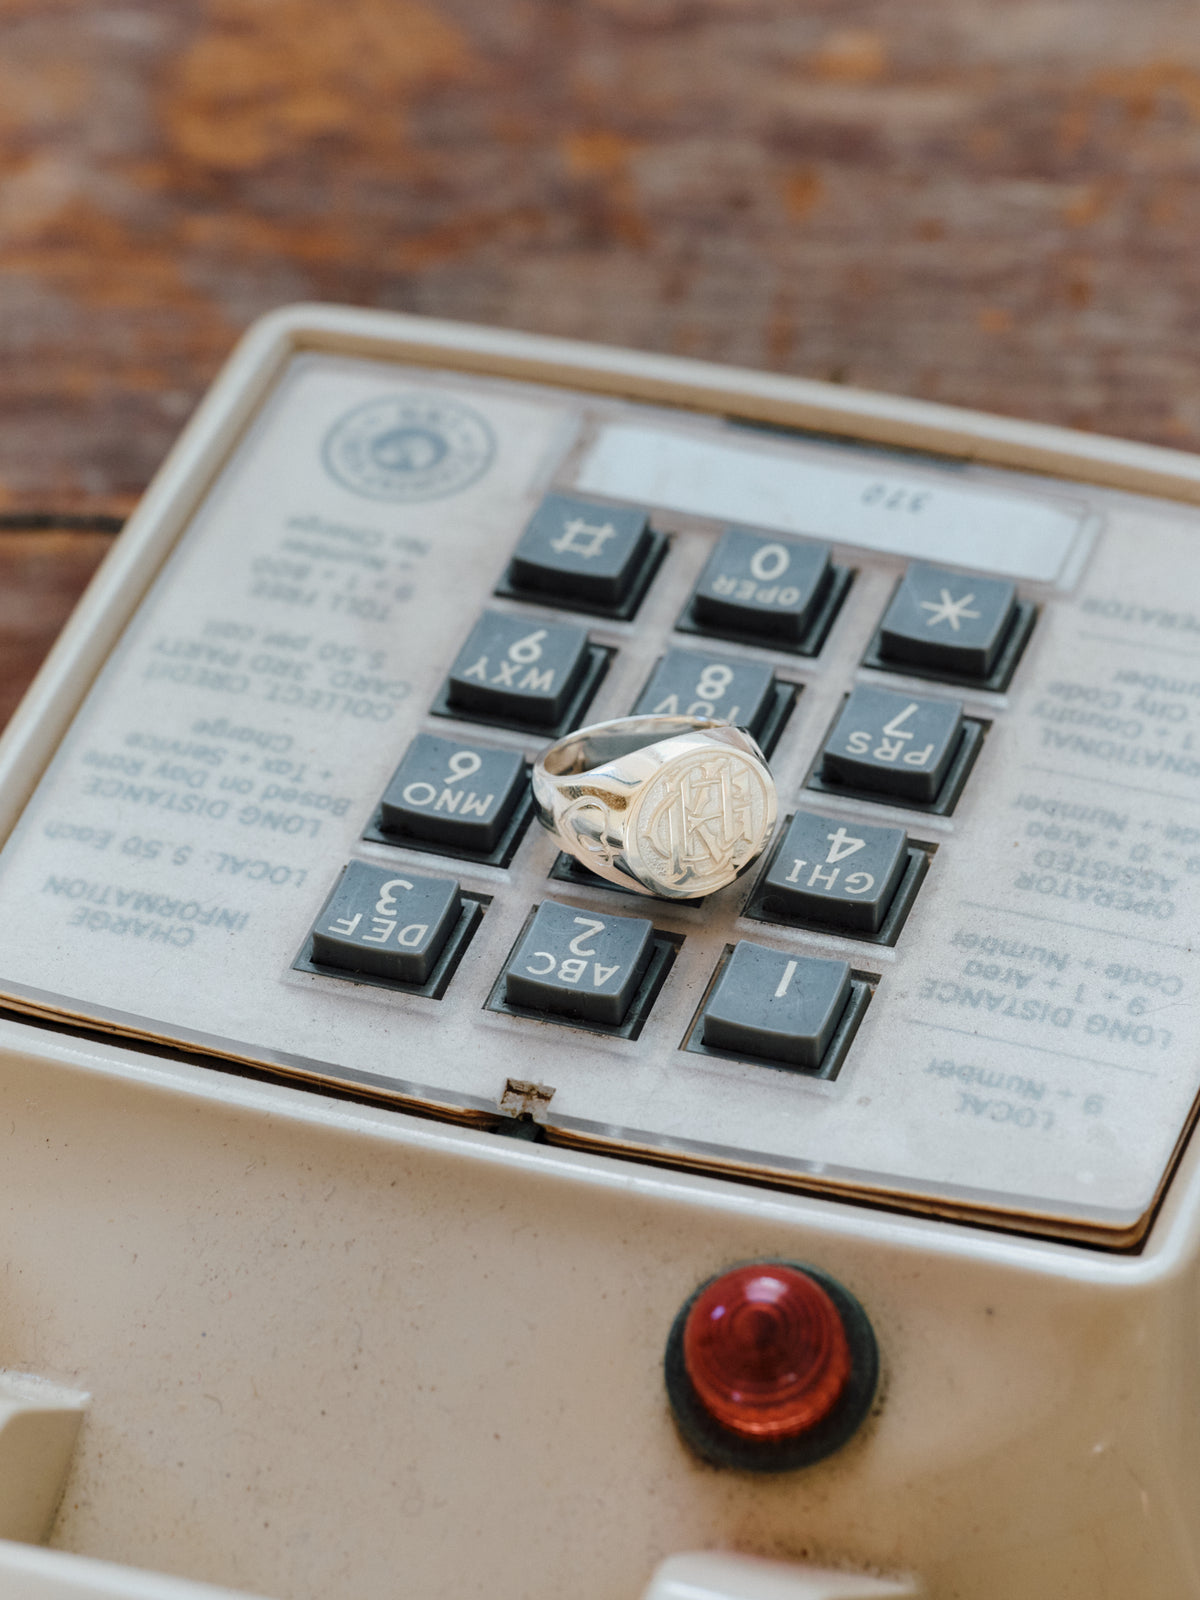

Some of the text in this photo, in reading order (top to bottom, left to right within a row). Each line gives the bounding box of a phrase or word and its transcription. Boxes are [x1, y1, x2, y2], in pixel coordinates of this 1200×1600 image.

[711, 575, 799, 606] OPER
[508, 630, 548, 664] 9
[463, 655, 555, 692] WXY
[696, 664, 734, 701] 8
[191, 718, 294, 753] Charge
[882, 703, 918, 740] 7
[845, 731, 935, 766] PRS
[153, 761, 208, 789] Day
[219, 775, 254, 795] on
[443, 750, 482, 785] 6
[81, 776, 322, 838] LONG DISTANCE
[260, 783, 350, 817] Based
[402, 782, 495, 817] MNO
[825, 827, 866, 863] 4
[785, 858, 875, 894] GHI
[41, 875, 250, 932] INFORMATION
[375, 879, 414, 916] 3
[1013, 872, 1176, 921] OPERATOR
[67, 906, 194, 948] CHARGE
[327, 912, 429, 947] DEF
[569, 916, 606, 957] 2
[525, 951, 620, 987] ABC
[950, 932, 1070, 972] Number
[774, 960, 798, 998] 1
[962, 959, 1033, 990] Area
[1103, 963, 1184, 997] Code
[918, 977, 1173, 1050] LONG DISTANCE
[923, 1058, 1046, 1101] Number
[955, 1091, 1055, 1131] LOCAL
